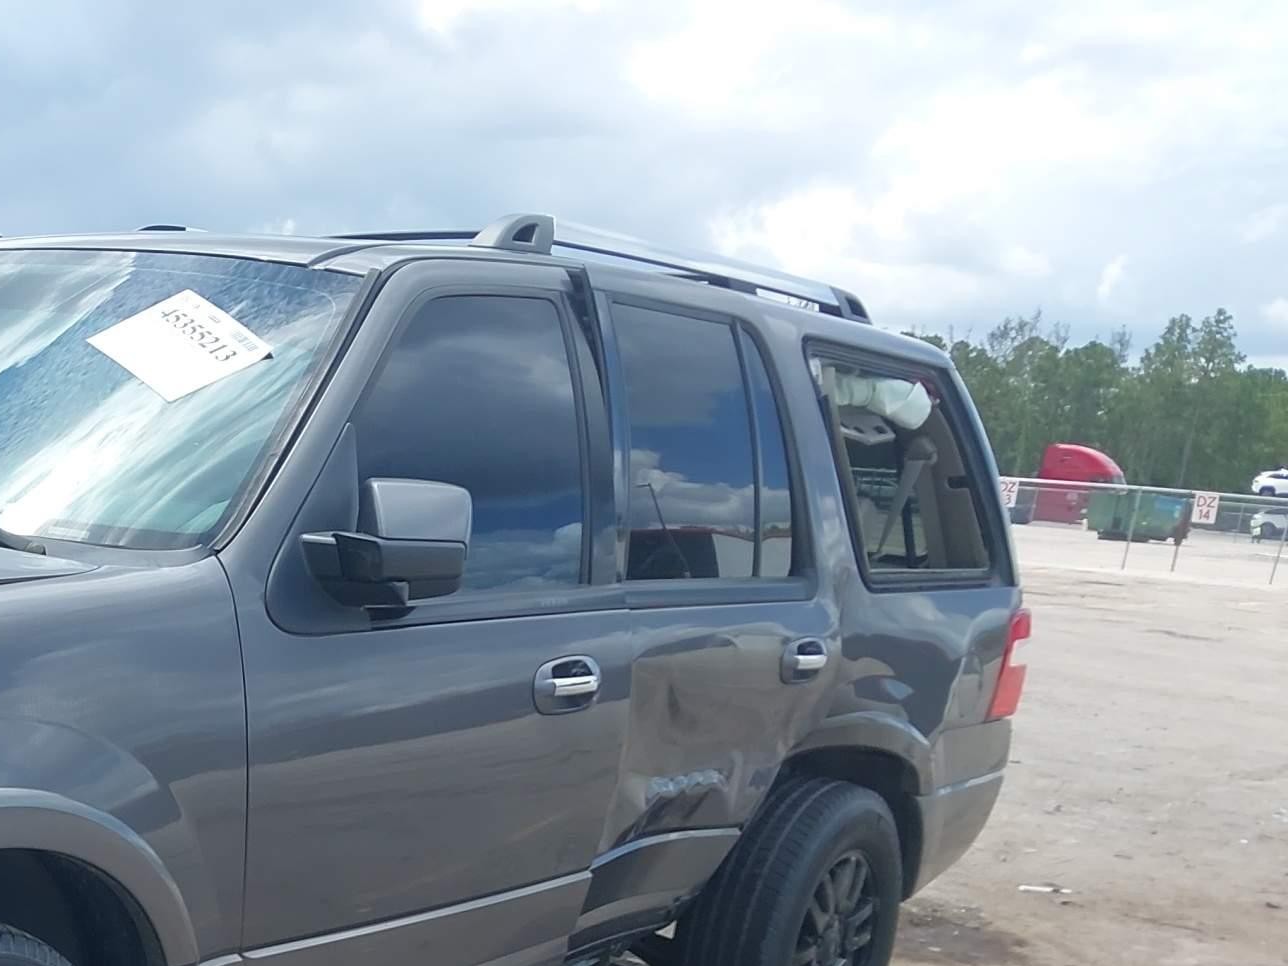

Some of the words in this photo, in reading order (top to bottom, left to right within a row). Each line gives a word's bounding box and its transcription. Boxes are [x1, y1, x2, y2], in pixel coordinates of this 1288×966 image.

[160, 308, 238, 362] 45355213
[1196, 495, 1217, 508] DZ
[1198, 508, 1211, 520] 14
